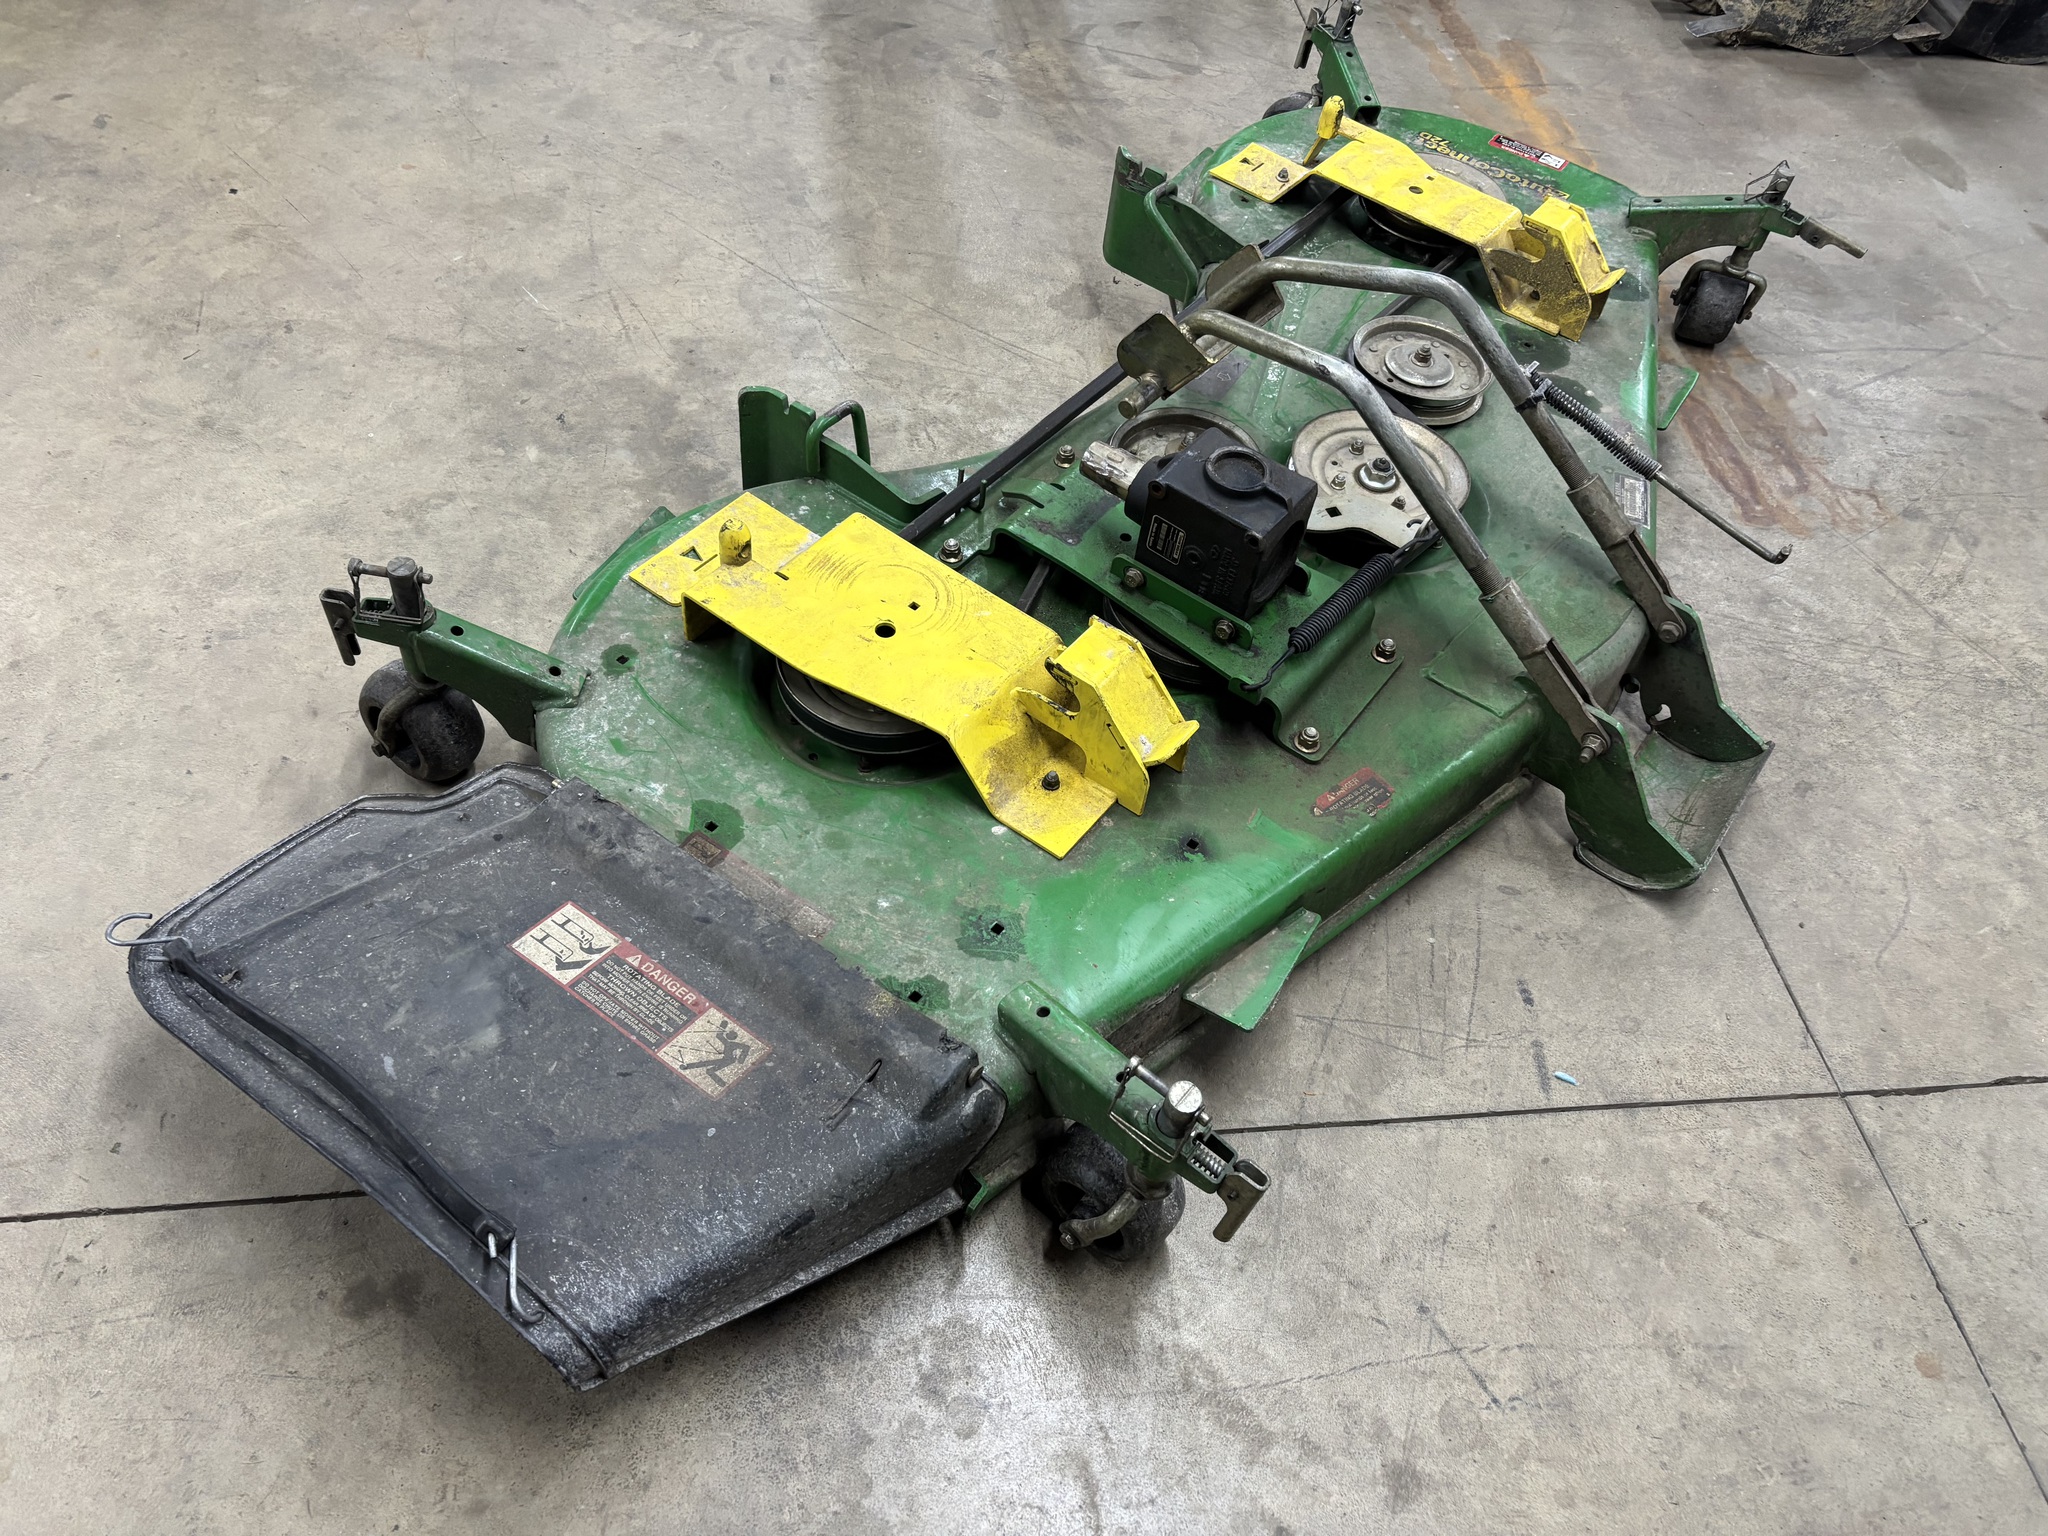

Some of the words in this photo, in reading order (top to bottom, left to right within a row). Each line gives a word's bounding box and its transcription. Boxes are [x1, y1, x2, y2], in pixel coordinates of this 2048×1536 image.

[1419, 131, 1451, 148] 72D
[605, 973, 637, 997] THROWN
[635, 995, 669, 1021] OBJECTS
[621, 963, 657, 990] ROTATING
[655, 988, 681, 1008] BLADE
[621, 971, 632, 979] PUT
[630, 977, 648, 991] HANDS
[652, 994, 665, 1004] FEET
[663, 1002, 681, 1015] UNDER
[639, 960, 697, 1005] DANGER
[587, 985, 600, 995] NOT
[636, 1022, 660, 1040] WITHOUT
[598, 1005, 615, 1017] PLACE
